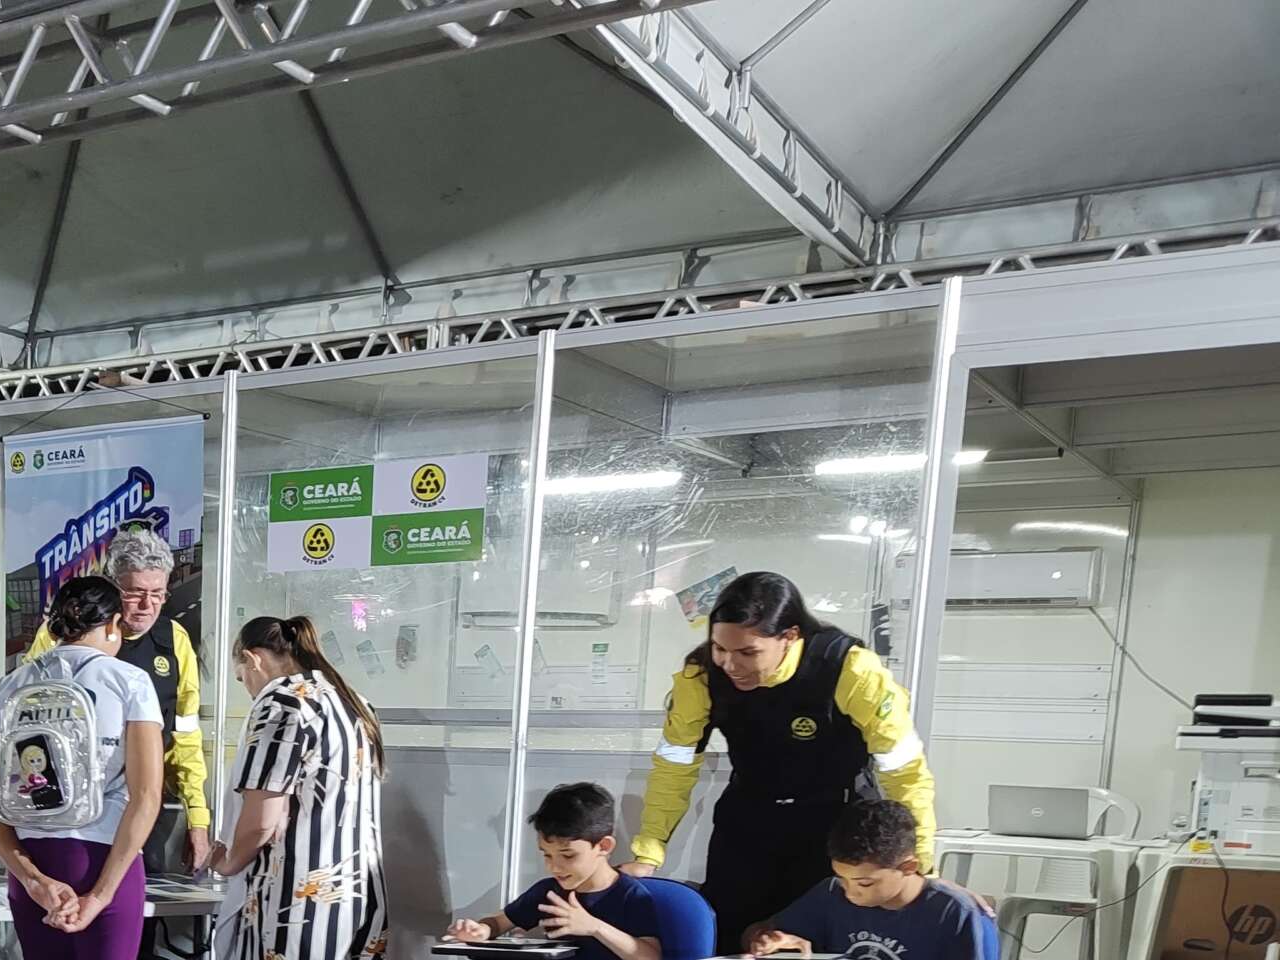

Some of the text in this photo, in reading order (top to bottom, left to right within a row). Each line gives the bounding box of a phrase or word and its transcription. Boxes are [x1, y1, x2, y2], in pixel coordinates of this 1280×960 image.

[47, 444, 85, 461] CEARÁ
[303, 476, 362, 499] CEARÁ
[41, 481, 143, 579] TRÂNSITO
[407, 520, 472, 542] CEARÁ
